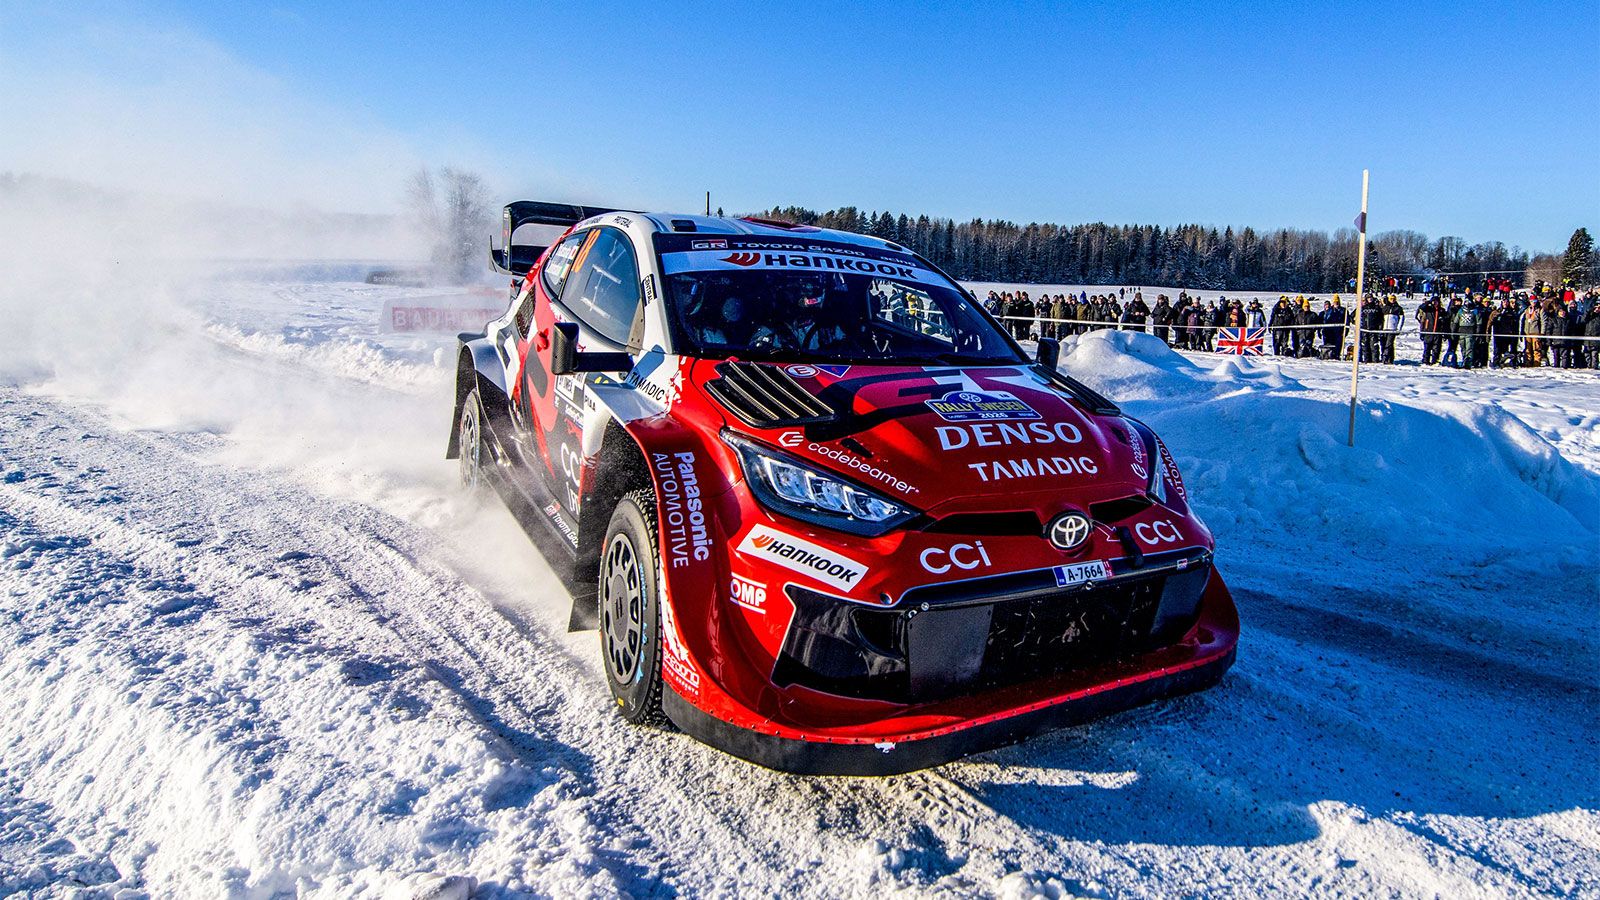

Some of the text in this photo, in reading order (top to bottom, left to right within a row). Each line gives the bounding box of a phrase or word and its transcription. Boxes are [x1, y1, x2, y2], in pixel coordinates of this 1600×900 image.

[733, 242, 806, 250] TOYOTA
[628, 372, 665, 402] TAMADIC
[933, 401, 1029, 413] RALLY SWEDEN
[934, 422, 1083, 450] DENSO
[808, 442, 916, 494] codebeamer
[968, 457, 1098, 481] TAMADIC
[653, 453, 689, 568] AUTOMOTIVE
[674, 452, 713, 561] Panasonic
[1067, 565, 1103, 582] A-7664
[731, 579, 767, 607] OMP
